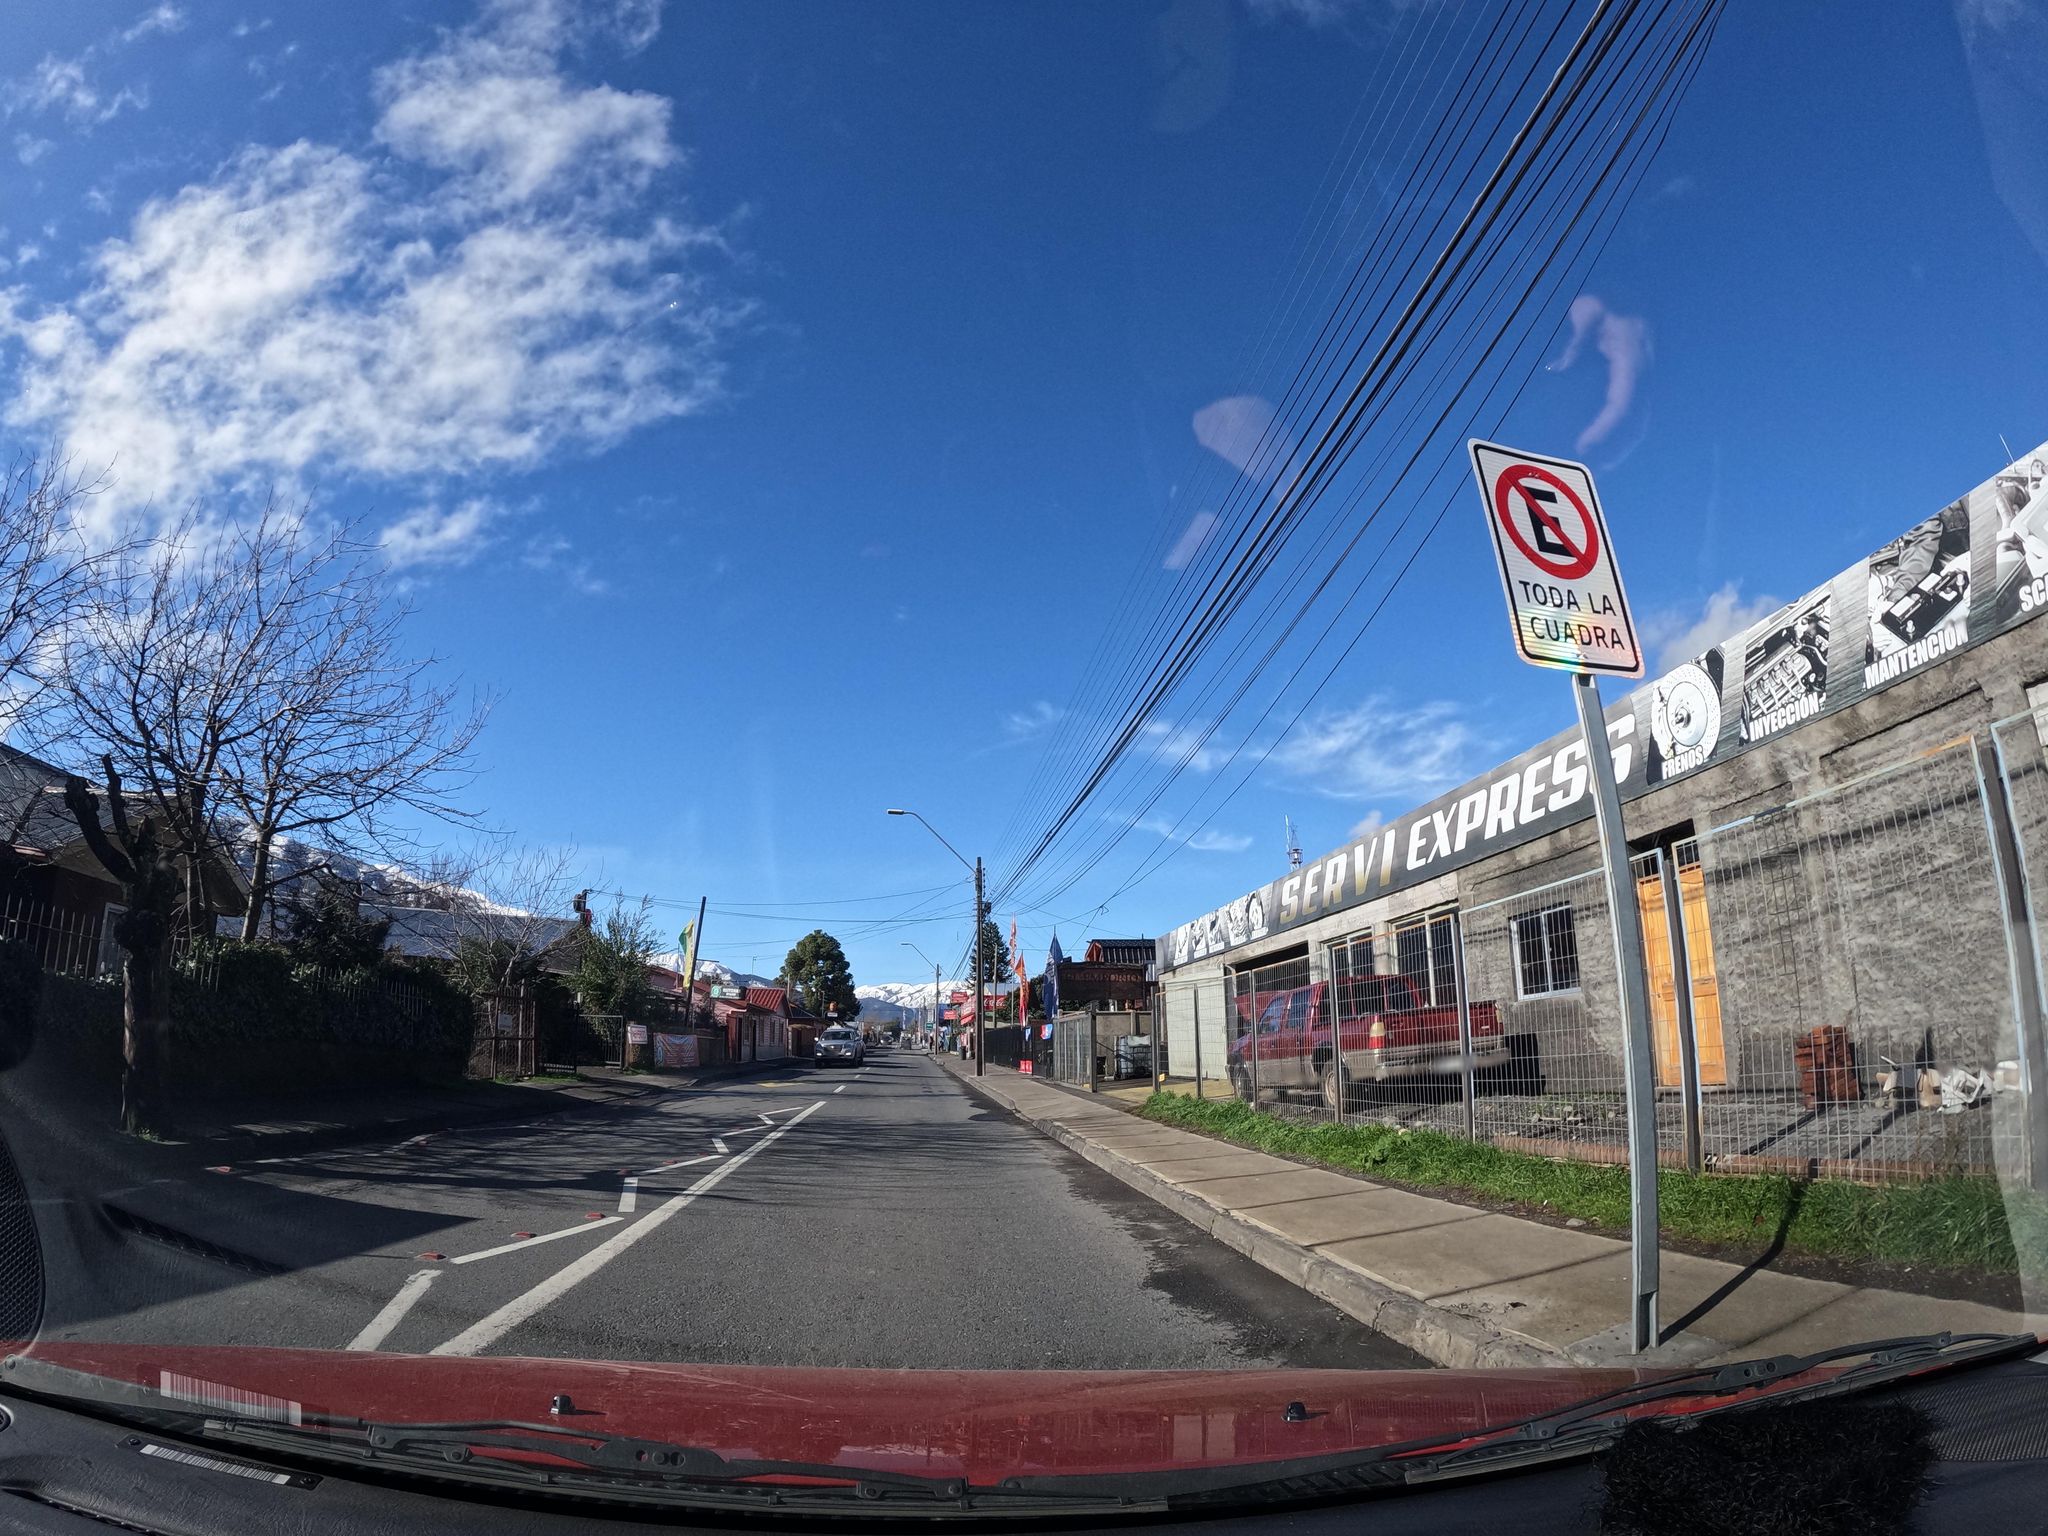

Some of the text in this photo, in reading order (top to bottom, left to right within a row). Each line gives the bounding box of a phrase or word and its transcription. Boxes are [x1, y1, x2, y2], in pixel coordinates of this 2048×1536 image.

[1523, 486, 1578, 558] E
[1518, 580, 1617, 617] TODA LA
[1530, 616, 1625, 650] CUADRA
[1661, 745, 1704, 780] FRENOS
[1280, 829, 1396, 925] SERVI
